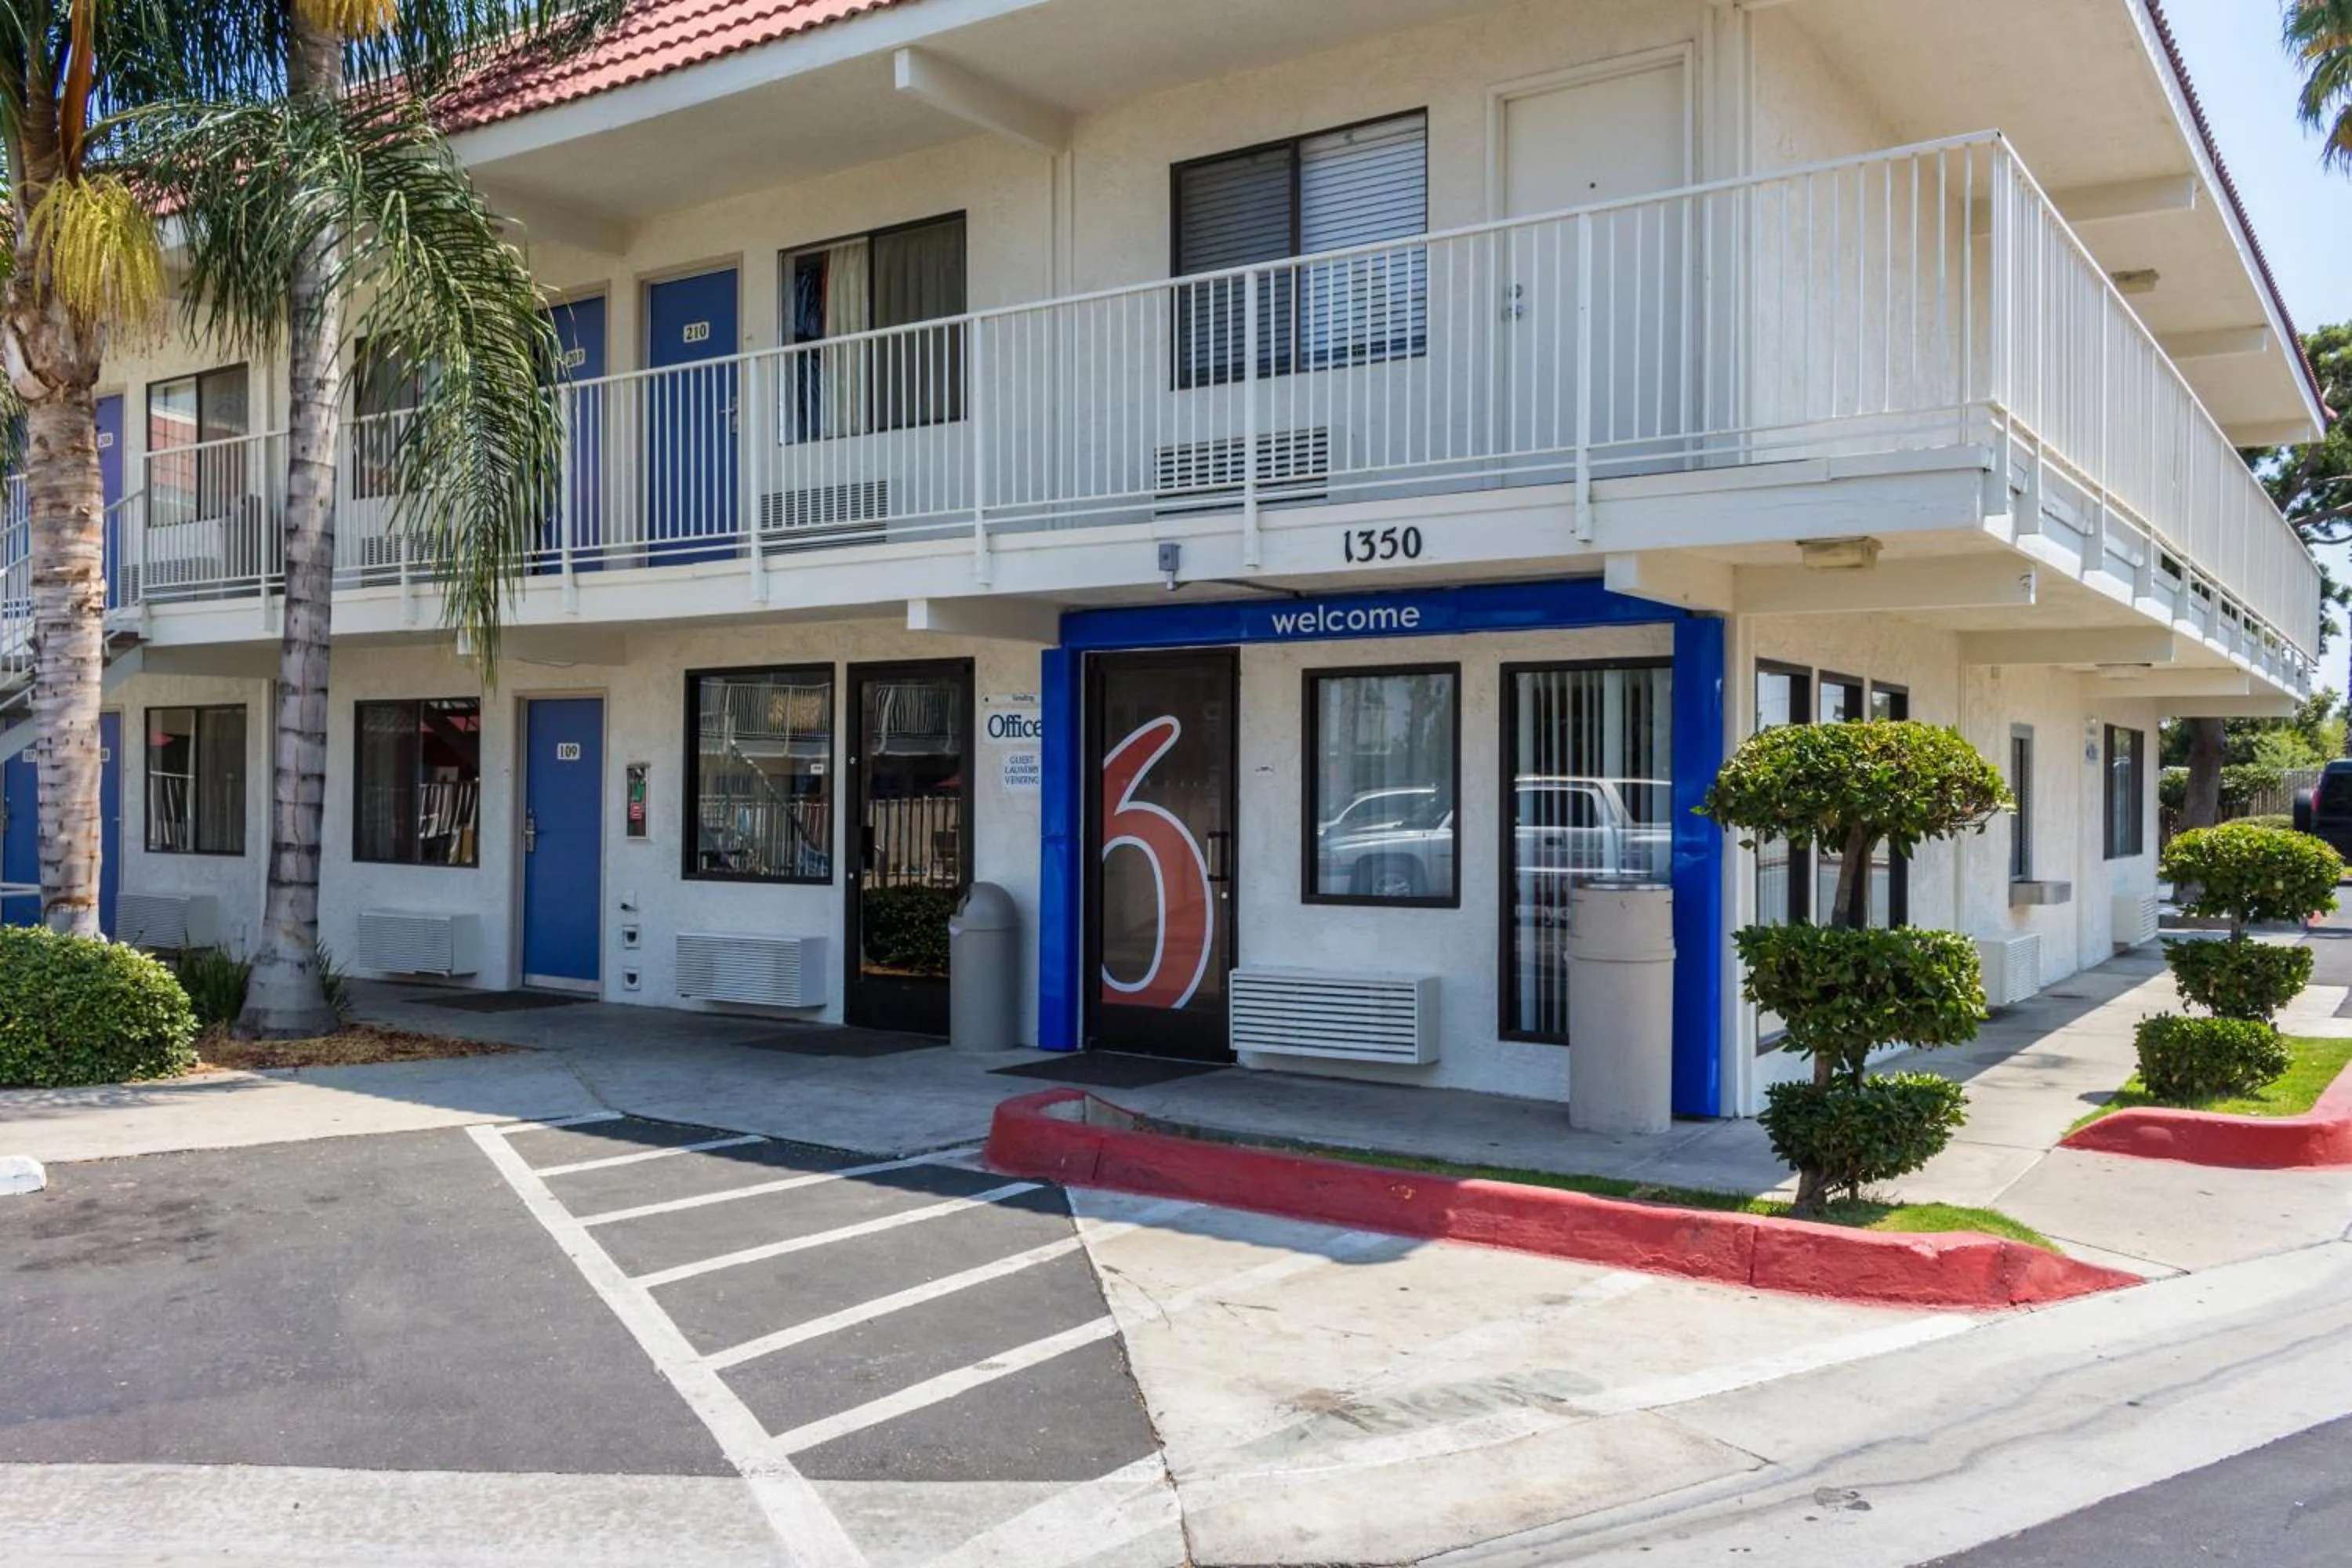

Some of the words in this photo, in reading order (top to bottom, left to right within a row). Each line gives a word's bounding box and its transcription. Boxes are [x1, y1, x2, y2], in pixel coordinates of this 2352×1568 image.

[686, 325, 707, 340] 210
[1344, 526, 1422, 563] 1350
[1272, 604, 1420, 634] welcome
[988, 714, 1042, 738] Office
[560, 746, 577, 758] 109
[1009, 755, 1035, 764] GUEST
[1004, 775, 1039, 785] VENDING
